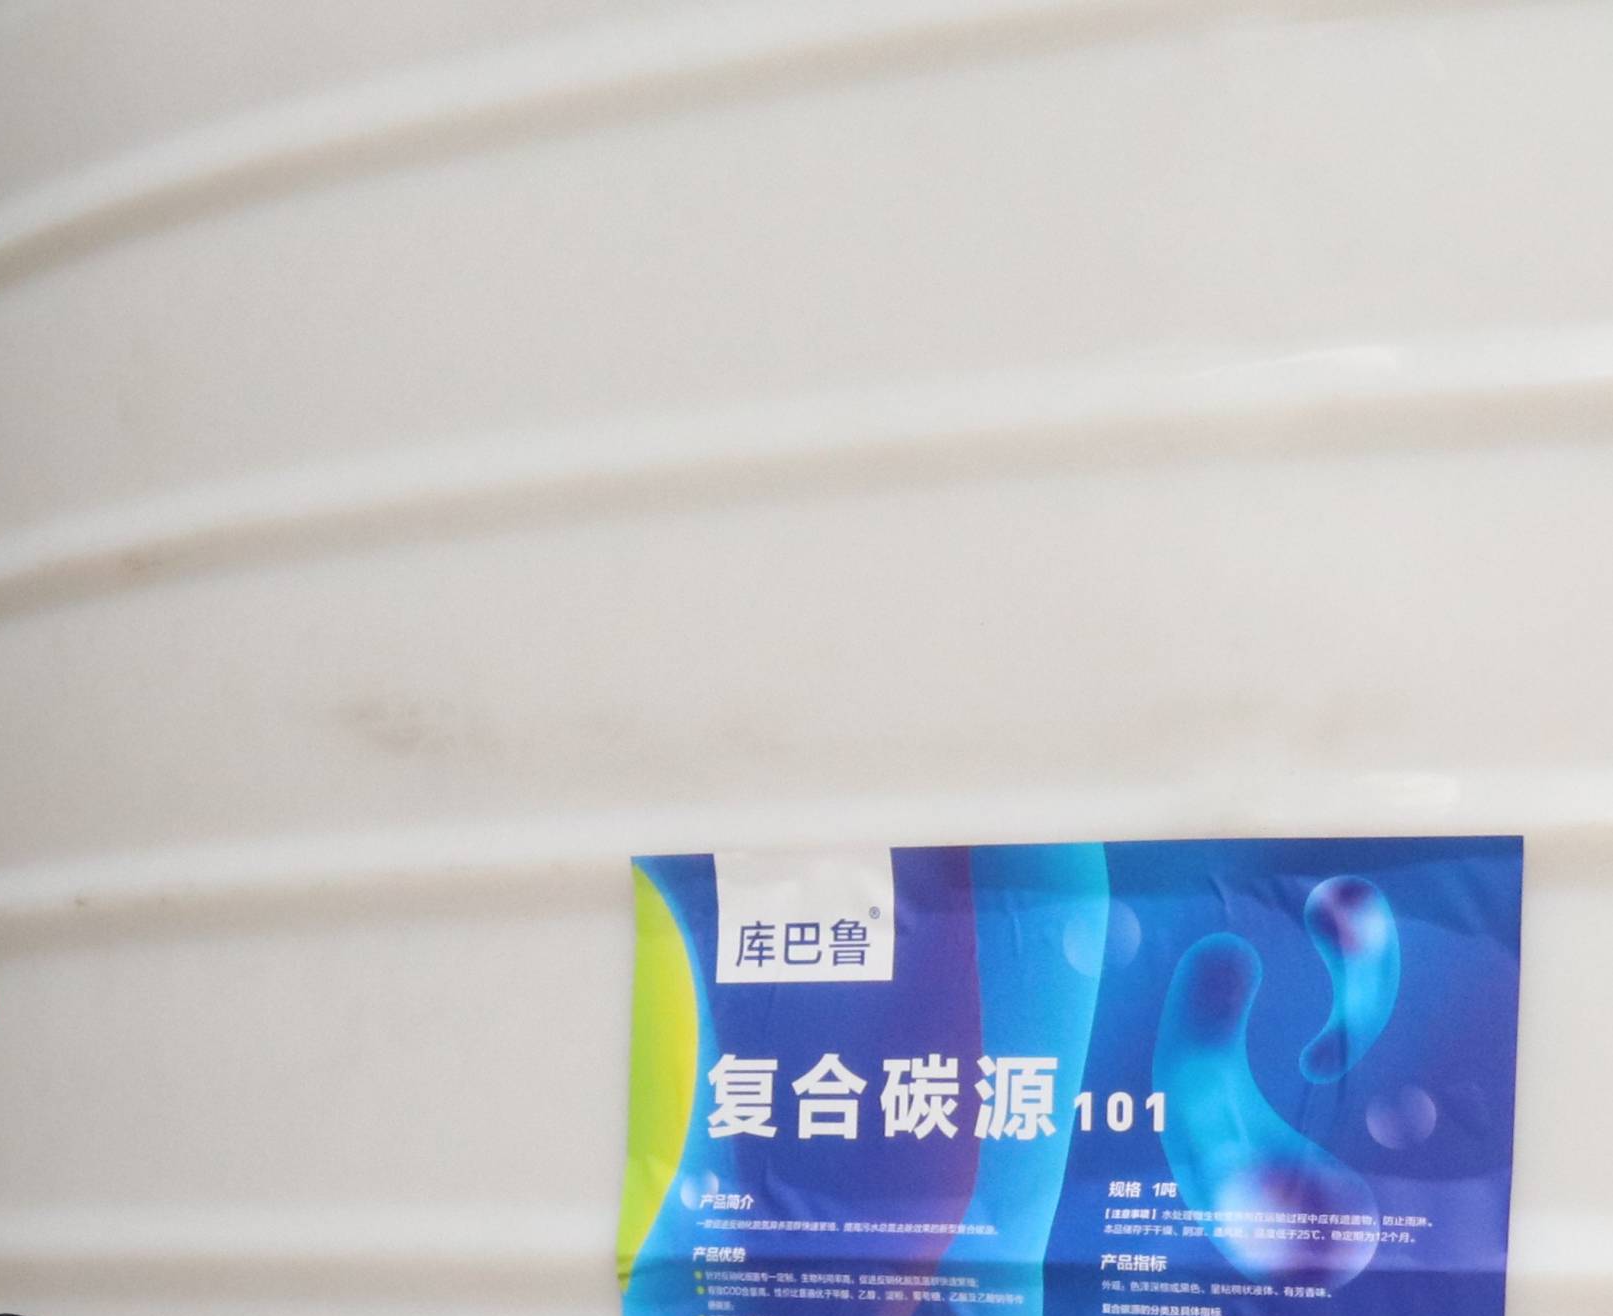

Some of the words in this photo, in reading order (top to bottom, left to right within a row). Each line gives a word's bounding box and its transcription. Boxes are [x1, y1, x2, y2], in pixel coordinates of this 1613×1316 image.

[706, 1053, 1059, 1141] 复合碳源
[1073, 1092, 1168, 1133] 101
[1107, 1181, 1142, 1198] 规格
[1151, 1182, 1178, 1198] 1吨
[699, 1194, 754, 1210] 产品简介
[692, 1247, 746, 1262] 产品优势
[1100, 1253, 1168, 1272] 产品指标
